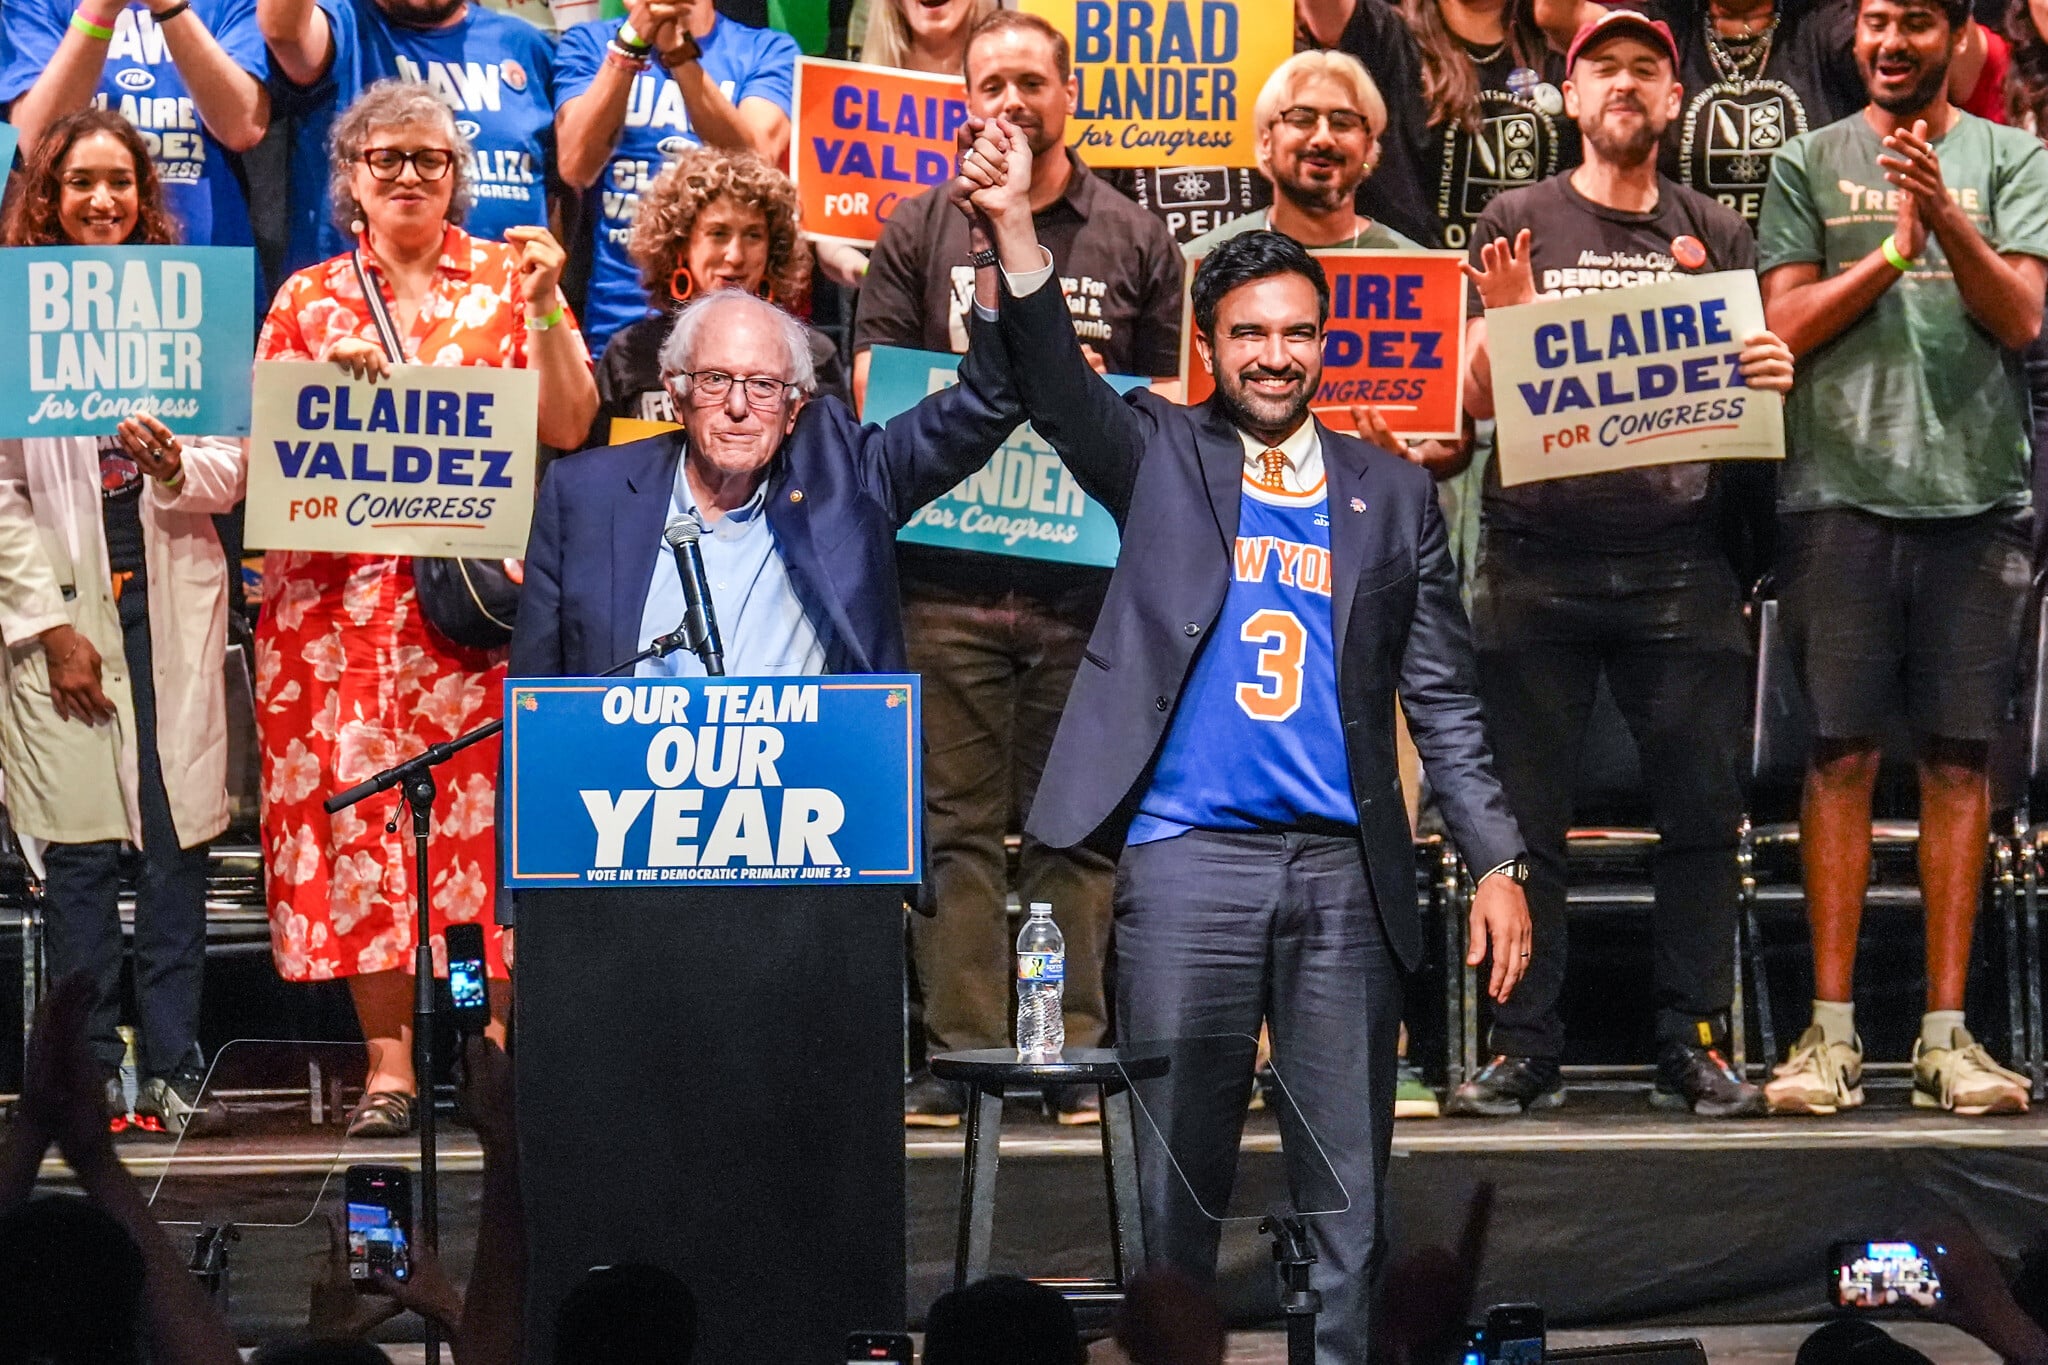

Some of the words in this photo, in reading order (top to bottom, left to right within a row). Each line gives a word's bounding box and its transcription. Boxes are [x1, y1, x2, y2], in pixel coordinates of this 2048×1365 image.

[107, 8, 173, 64] AW
[1074, 0, 1239, 64] BRAD
[1074, 68, 1238, 121] LANDER
[812, 137, 960, 186] VALD
[1073, 124, 1112, 151] for
[1121, 123, 1233, 156] Congress
[824, 192, 869, 217] FOR
[28, 260, 202, 331] BRAD
[1327, 274, 1424, 320] IRE
[1324, 330, 1443, 369] DEZ
[1534, 298, 1732, 369] CLAIRE
[28, 332, 203, 392] LANDER
[1517, 353, 1750, 416] VALDEZ
[28, 393, 79, 425] for
[81, 392, 200, 422] Congress
[296, 385, 494, 438] CLAIRE
[1316, 378, 1426, 402] NGRESS
[1542, 424, 1590, 454] FOR
[273, 441, 513, 488] VALDEZ
[289, 496, 338, 522] FOR
[960, 504, 1079, 546] Congress
[1235, 608, 1308, 722] 3
[602, 686, 690, 725] OUR
[704, 685, 819, 723] TEAM
[646, 725, 785, 789] OUR
[579, 788, 846, 868] YEAR
[586, 869, 618, 881] VOTE
[619, 869, 634, 881] IN
[636, 869, 658, 881] THE
[660, 868, 738, 880] DEMOCRATIC
[741, 867, 799, 880] PRIMARY
[800, 867, 832, 879] JUNE
[834, 866, 852, 878] 23
